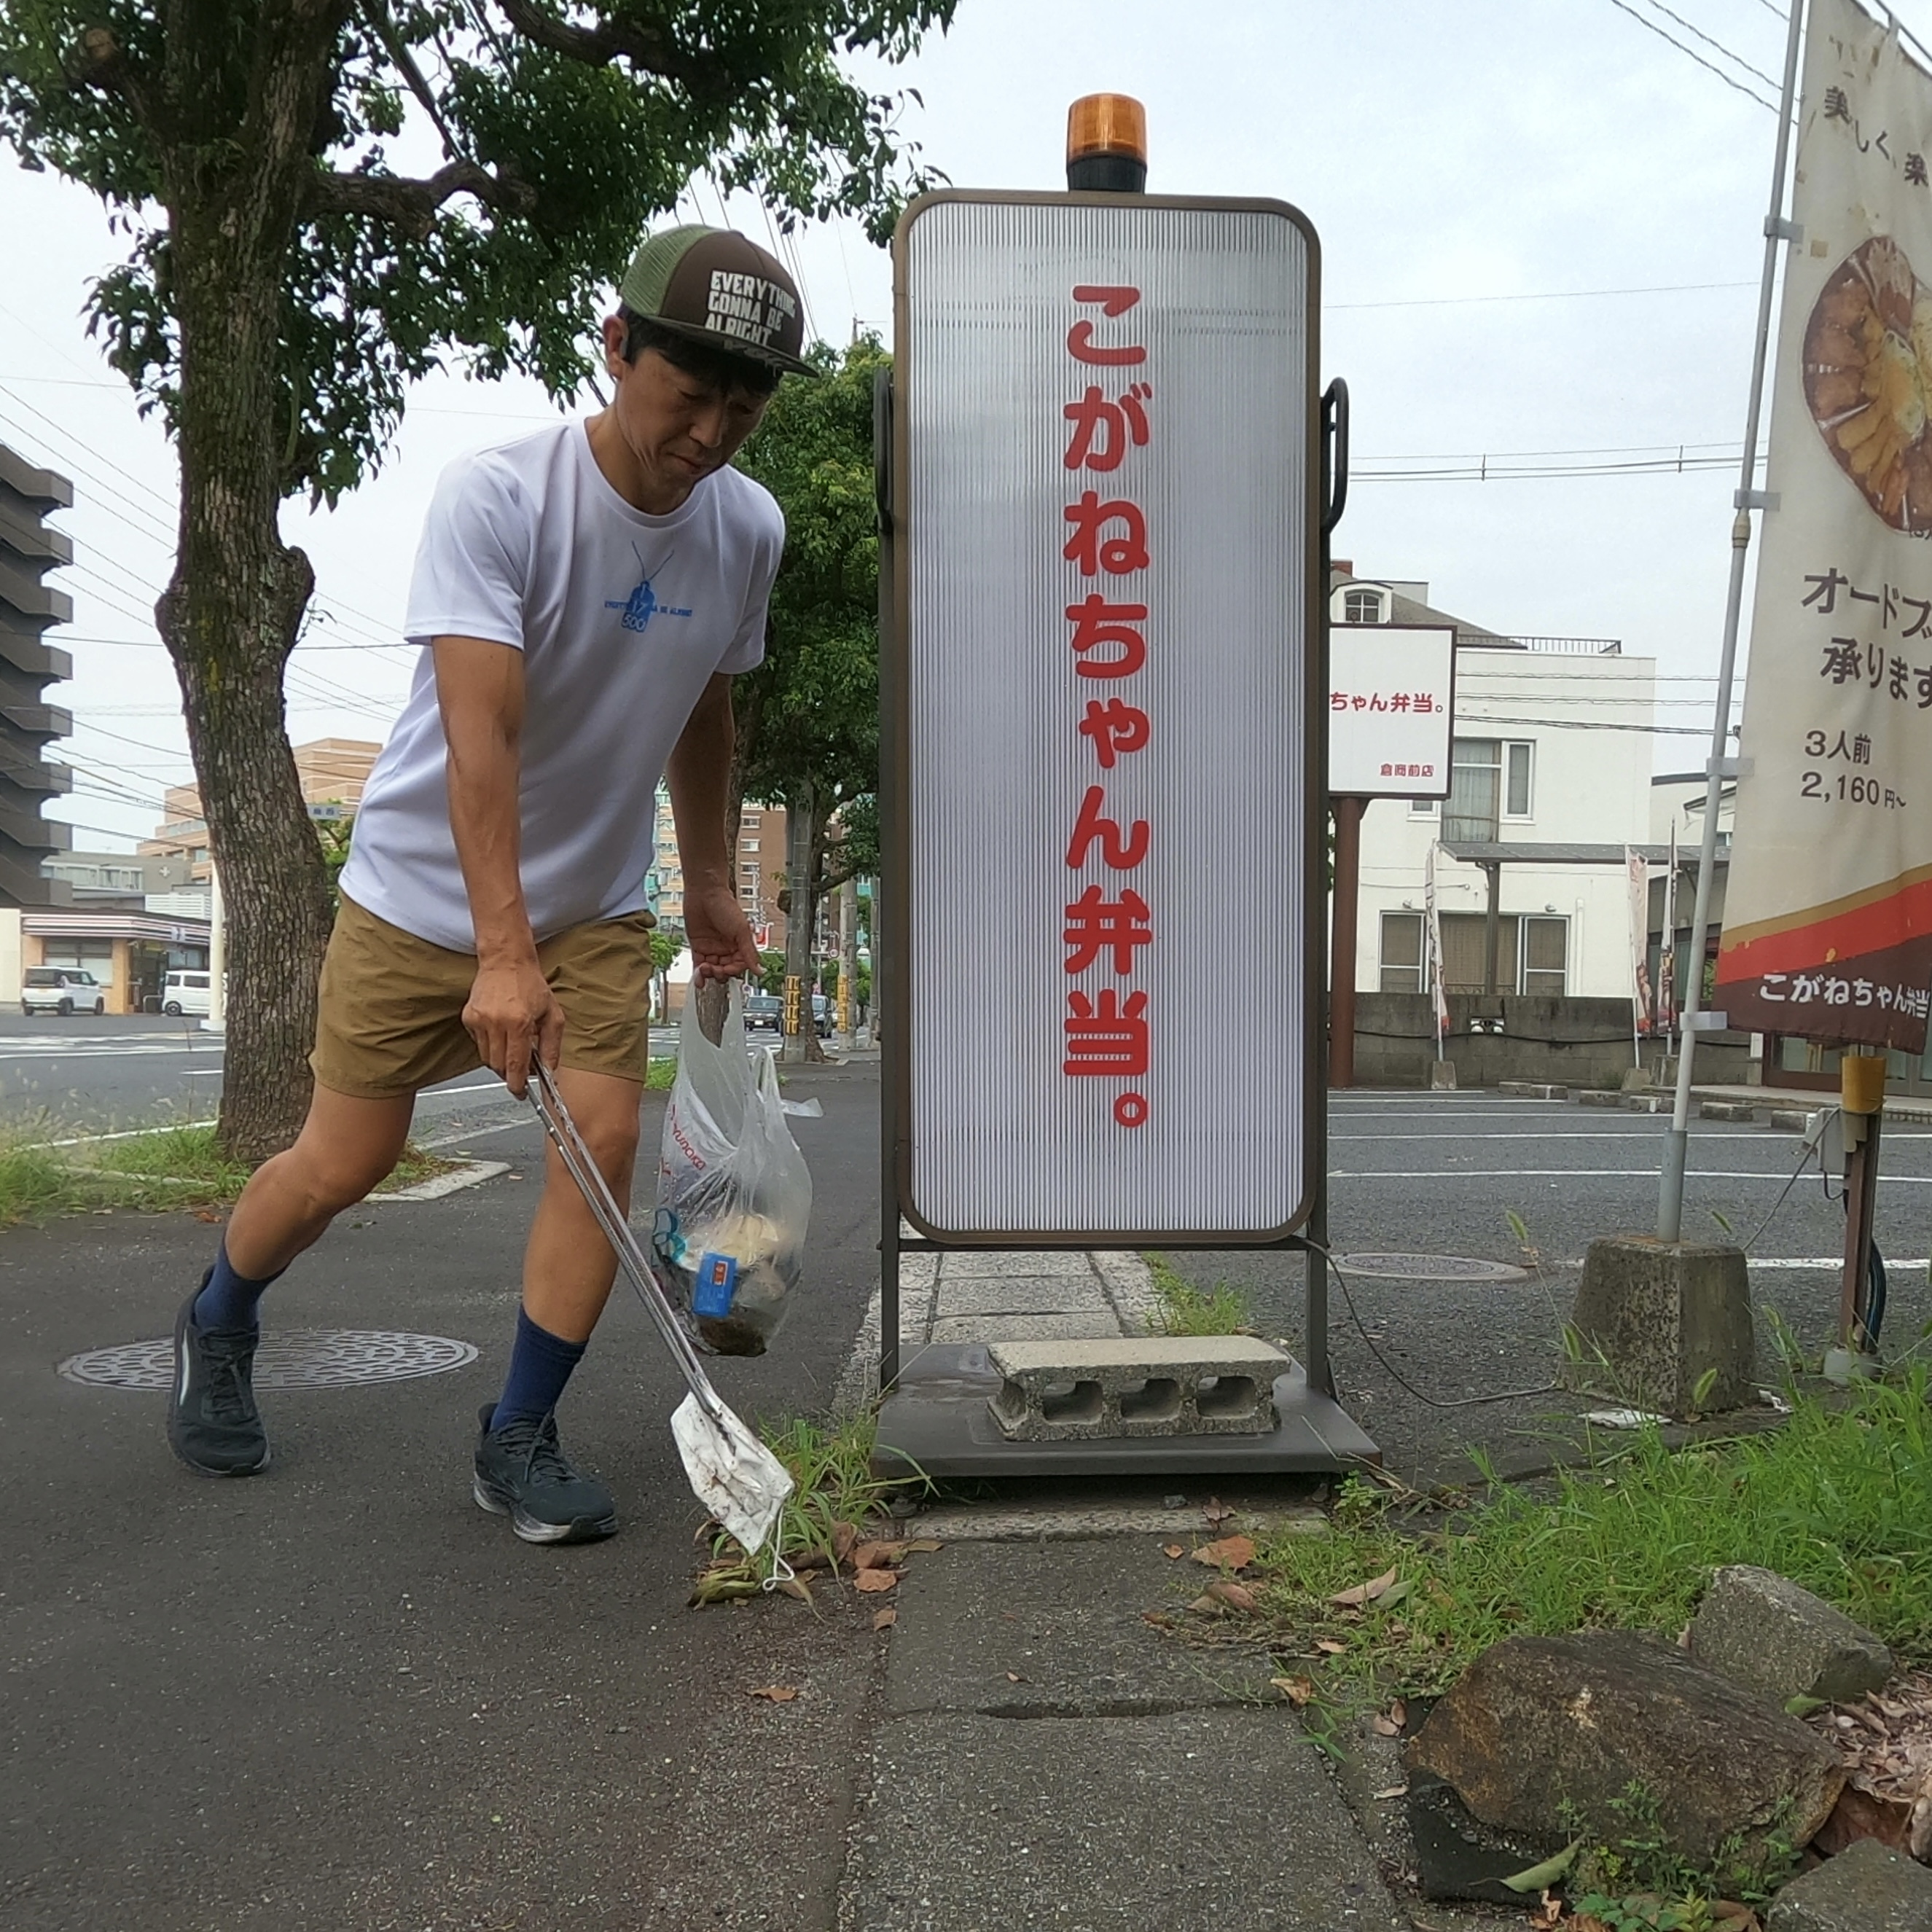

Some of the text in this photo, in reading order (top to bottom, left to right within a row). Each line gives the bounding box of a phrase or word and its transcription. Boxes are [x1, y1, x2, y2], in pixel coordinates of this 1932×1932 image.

[708, 290, 784, 332] GONNA BE
[711, 270, 796, 318] EVERYTHING
[705, 312, 773, 347] ALRIGHT
[1063, 285, 1152, 1128] こがねちゃん弁当。
[1804, 730, 1872, 765] 3人前
